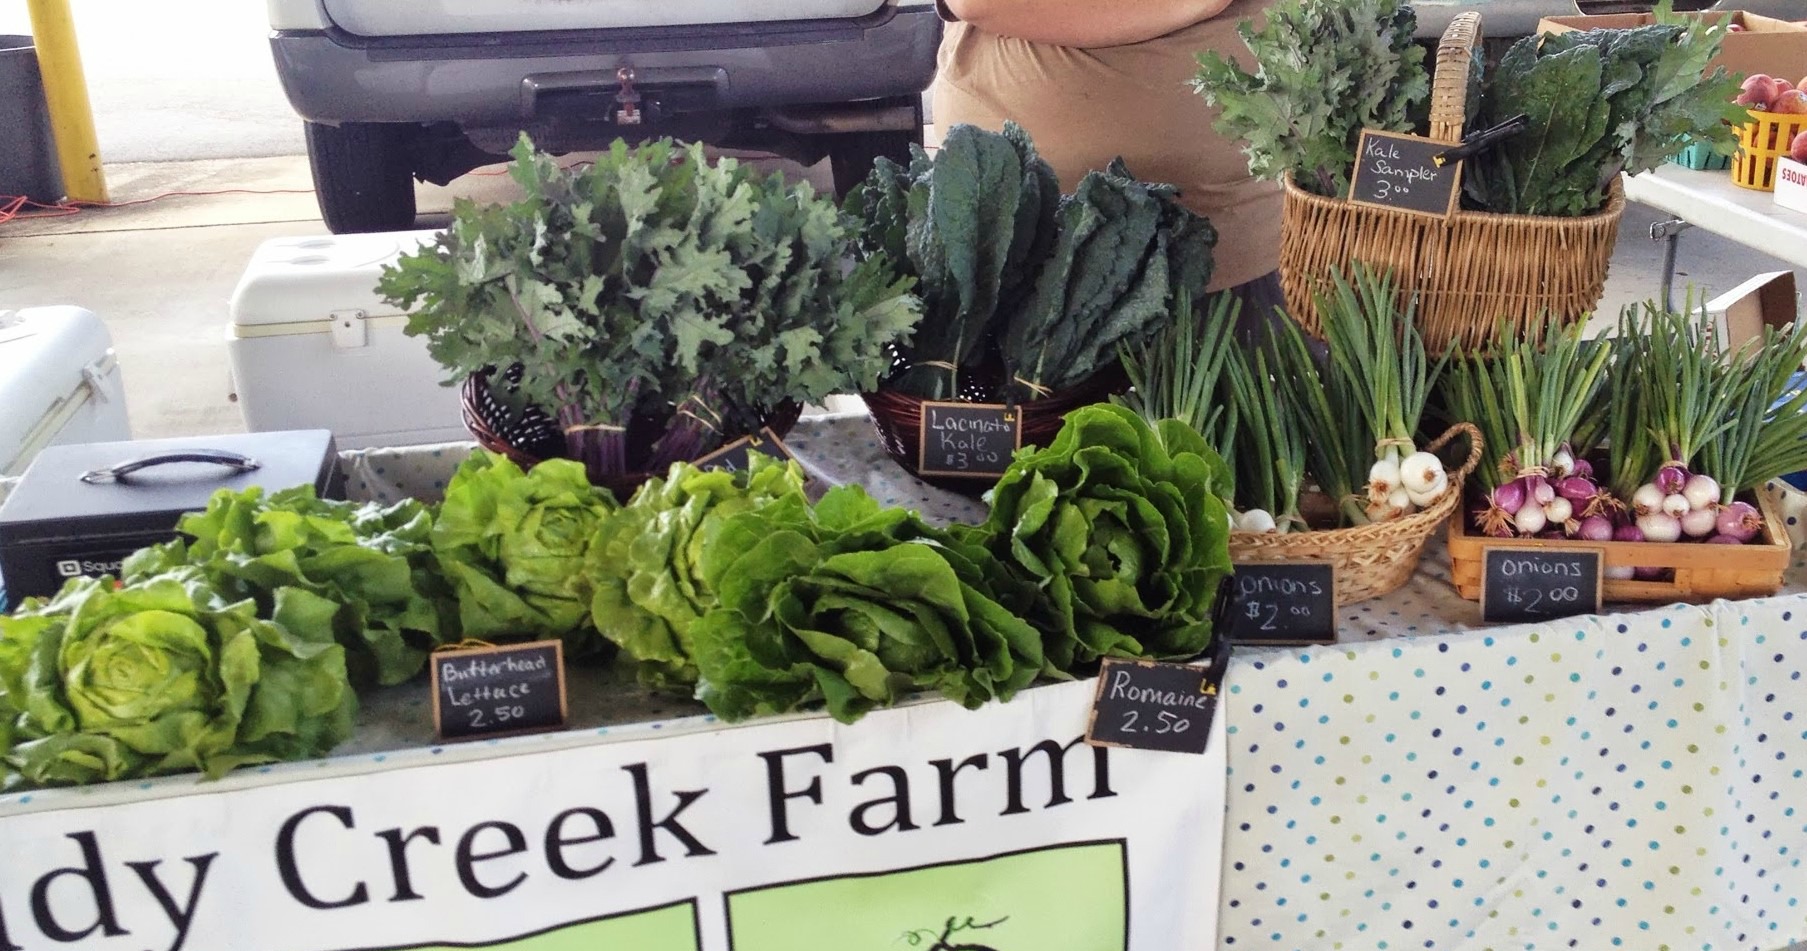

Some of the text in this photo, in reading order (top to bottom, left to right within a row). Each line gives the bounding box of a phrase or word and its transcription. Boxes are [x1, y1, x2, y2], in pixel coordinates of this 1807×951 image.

[1366, 137, 1400, 159] Kale
[1371, 160, 1437, 184] Sampler
[1782, 168, 1807, 187] ATOES
[932, 410, 1010, 433] Lacinato
[941, 431, 988, 451] Kale
[442, 656, 546, 682] Butterhead
[1110, 671, 1207, 709] Romaine
[468, 705, 524, 727] 2.50
[1120, 711, 1190, 733] 2.50
[275, 762, 717, 910] Creek
[757, 737, 1118, 845] Farm
